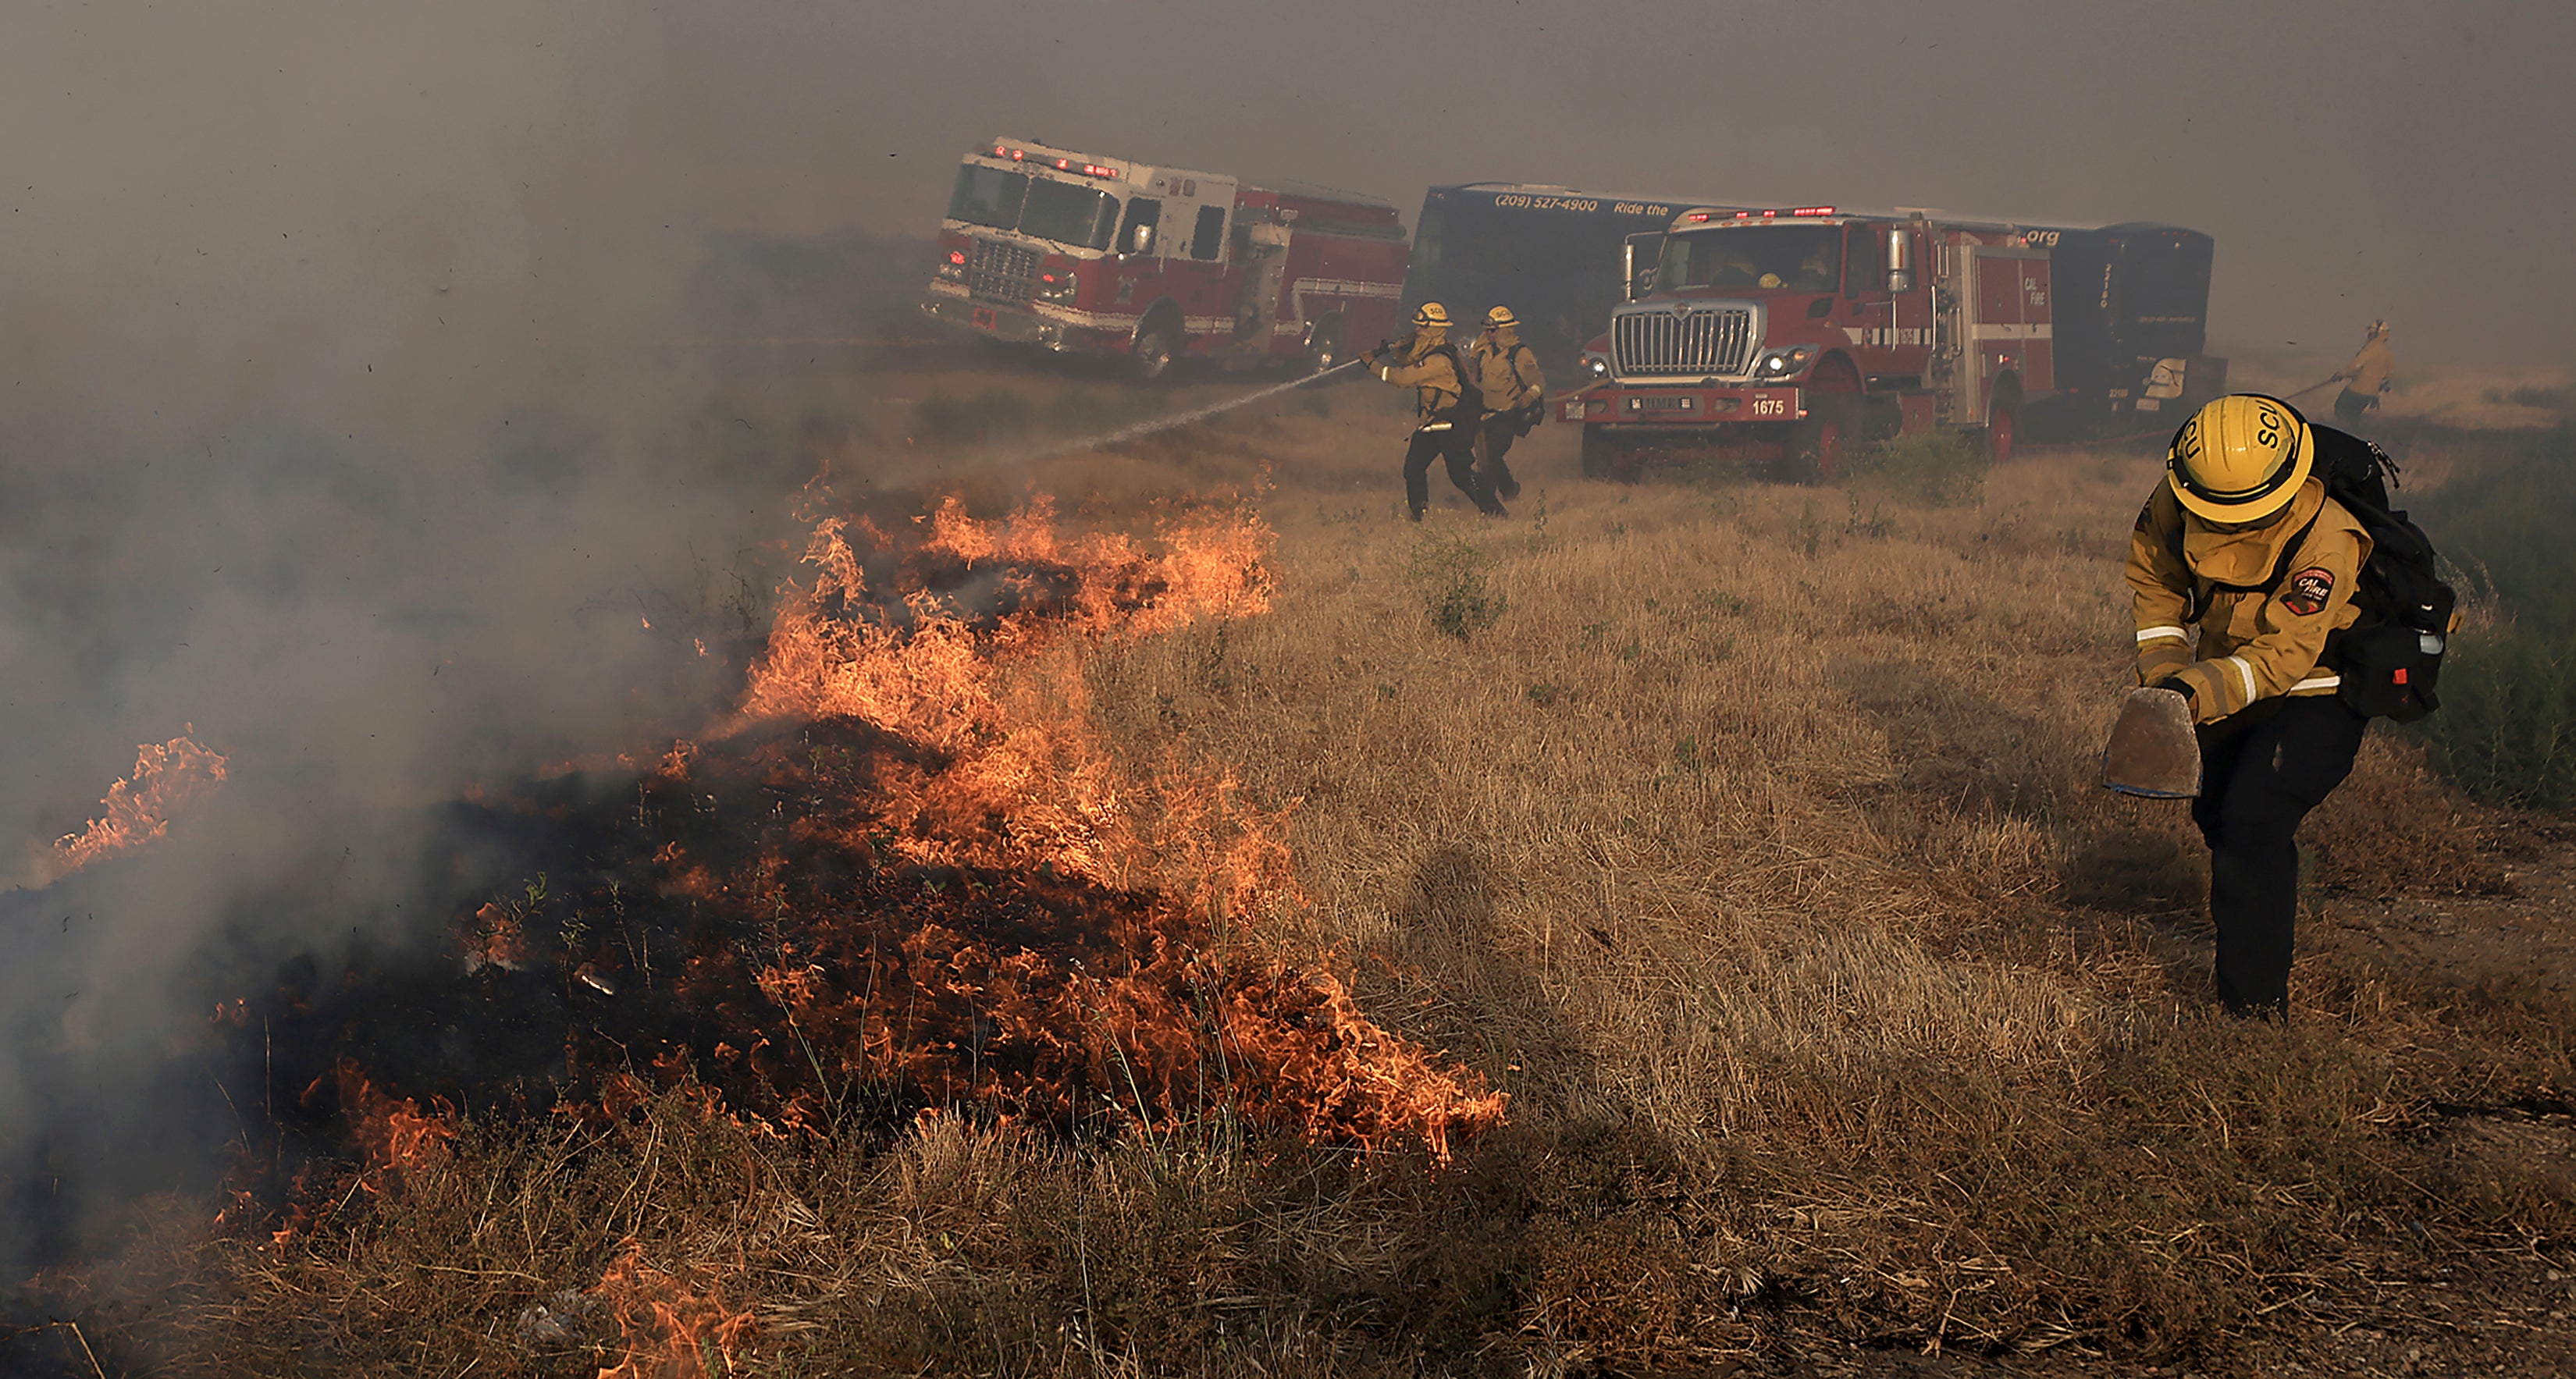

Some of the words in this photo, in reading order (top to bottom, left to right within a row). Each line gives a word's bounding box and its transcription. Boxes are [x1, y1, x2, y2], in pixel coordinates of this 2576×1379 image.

[1495, 194, 1532, 208] (209)
[1534, 197, 1598, 212] 527-4900
[1614, 201, 1643, 215] Ride
[1647, 204, 1669, 216] the
[2025, 277, 2037, 290] CAL
[2030, 292, 2044, 305] FIRE
[1752, 400, 1784, 415] 1675
[2255, 400, 2280, 449] SCU
[2184, 408, 2202, 460] CU
[2304, 585, 2329, 596] FIRE
